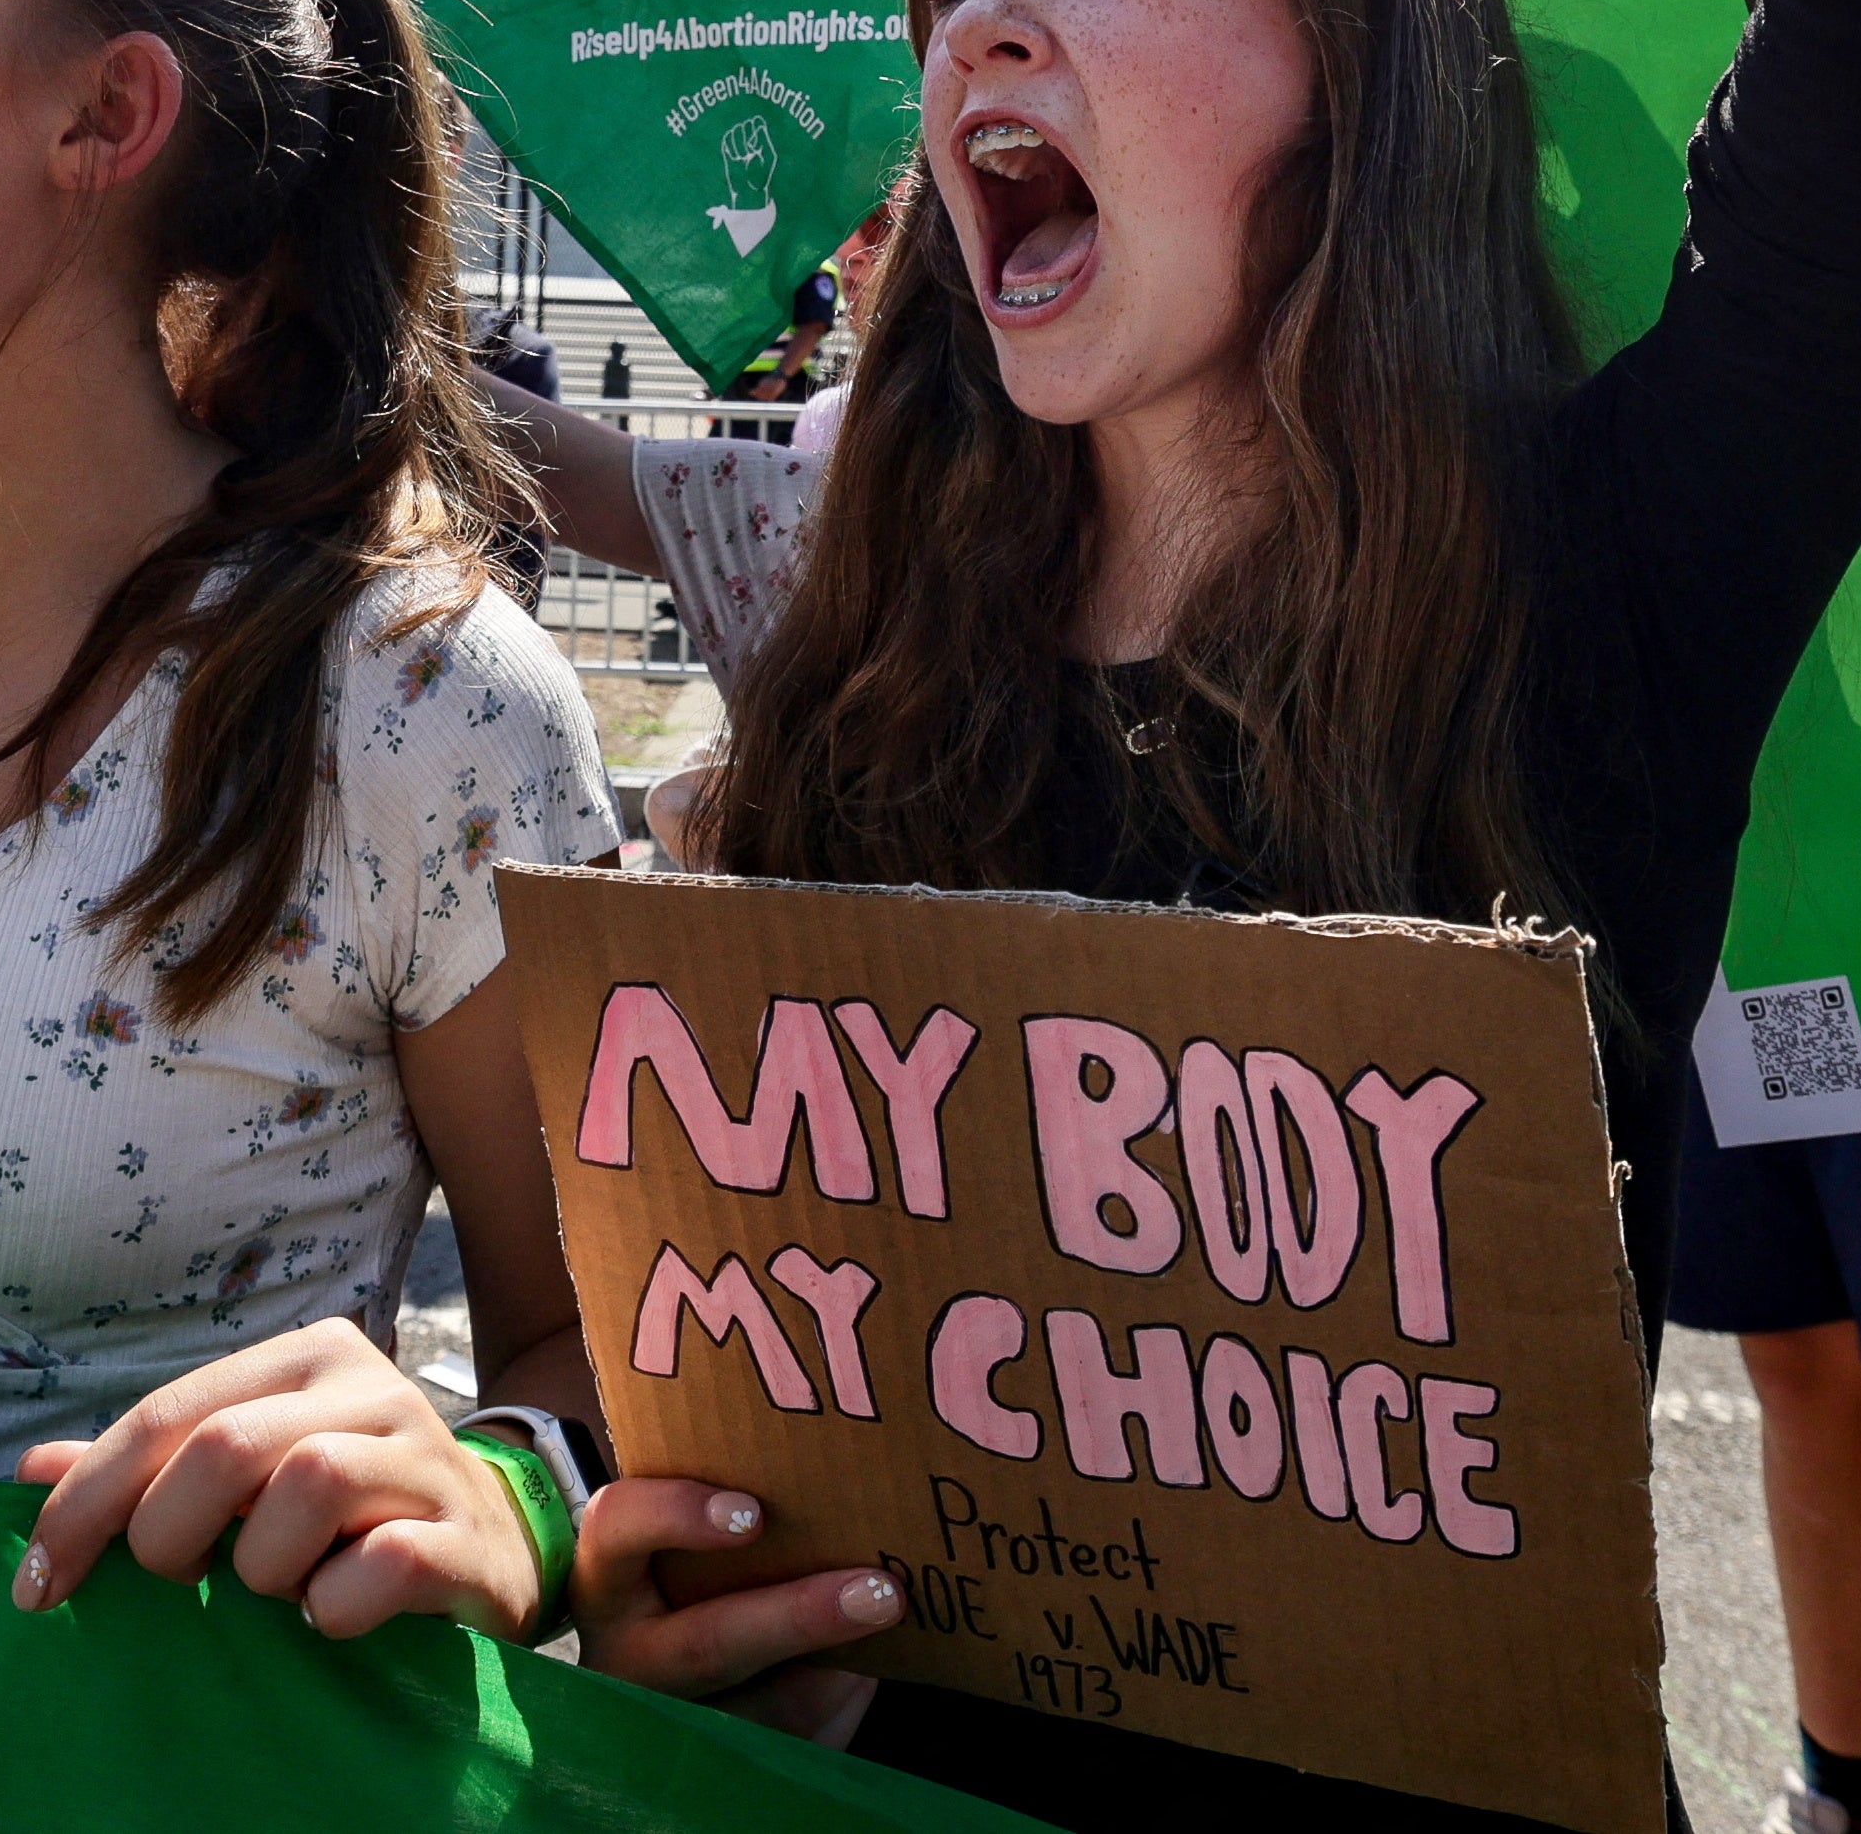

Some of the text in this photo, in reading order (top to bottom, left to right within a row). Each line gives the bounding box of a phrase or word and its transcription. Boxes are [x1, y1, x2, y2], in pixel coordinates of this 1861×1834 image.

[665, 65, 826, 142] #Green4Abortion
[574, 981, 1485, 1348] MY BODY
[629, 1239, 1521, 1561] MY CHOICE
[928, 1473, 1161, 1591] Protect
[1015, 1650, 1124, 1718] 1973
[1089, 1594, 1250, 1695] WADE
